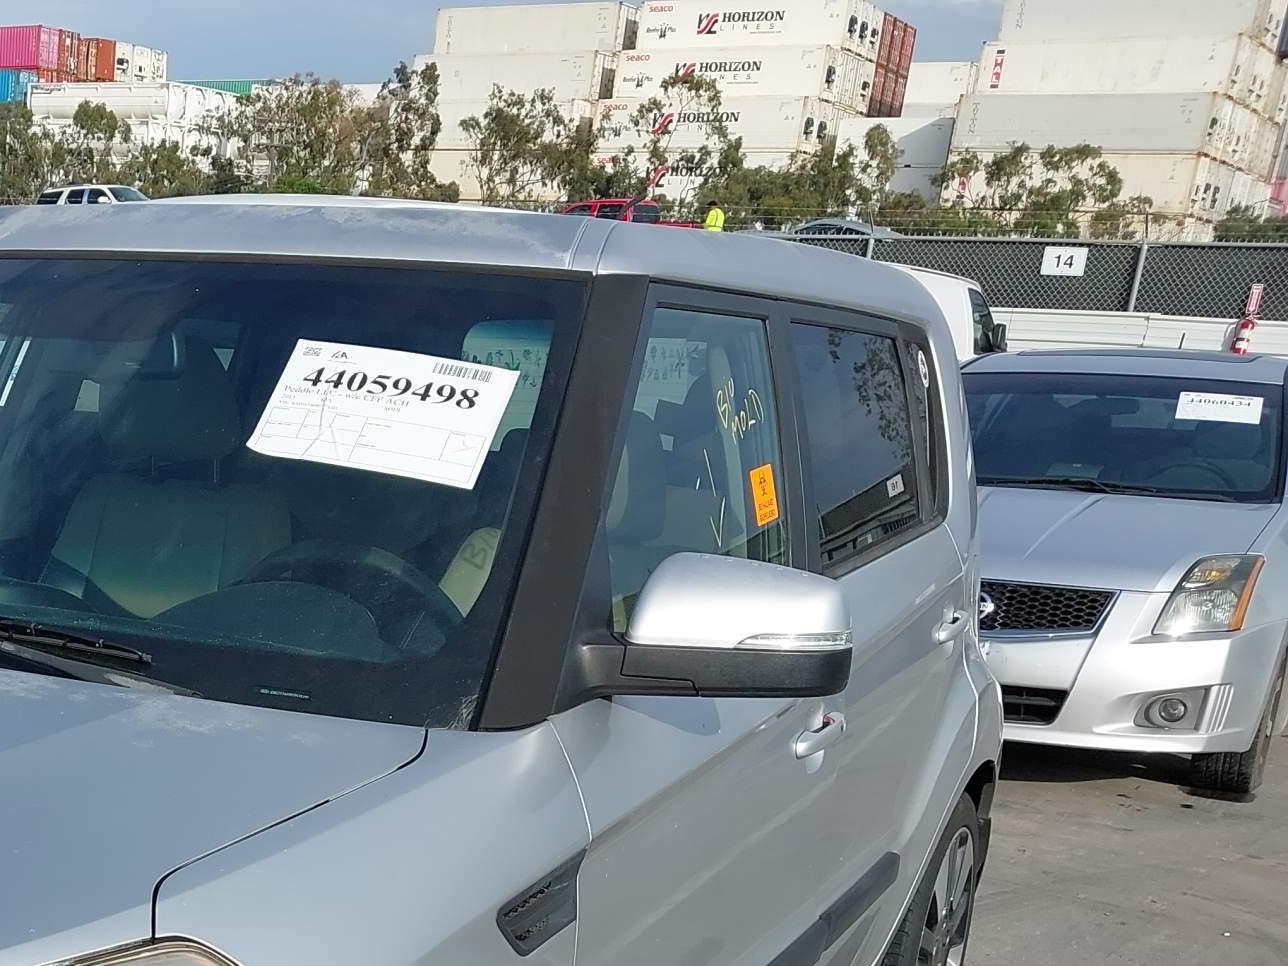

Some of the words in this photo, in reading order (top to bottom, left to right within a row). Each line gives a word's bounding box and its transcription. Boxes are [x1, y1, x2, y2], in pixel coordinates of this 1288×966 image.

[722, 10, 786, 23] HORIZON
[720, 23, 775, 31] LINES
[698, 61, 762, 72] HORIZON
[678, 112, 741, 123] HORIZON
[1054, 254, 1075, 269] 14
[302, 366, 480, 410] 44059498
